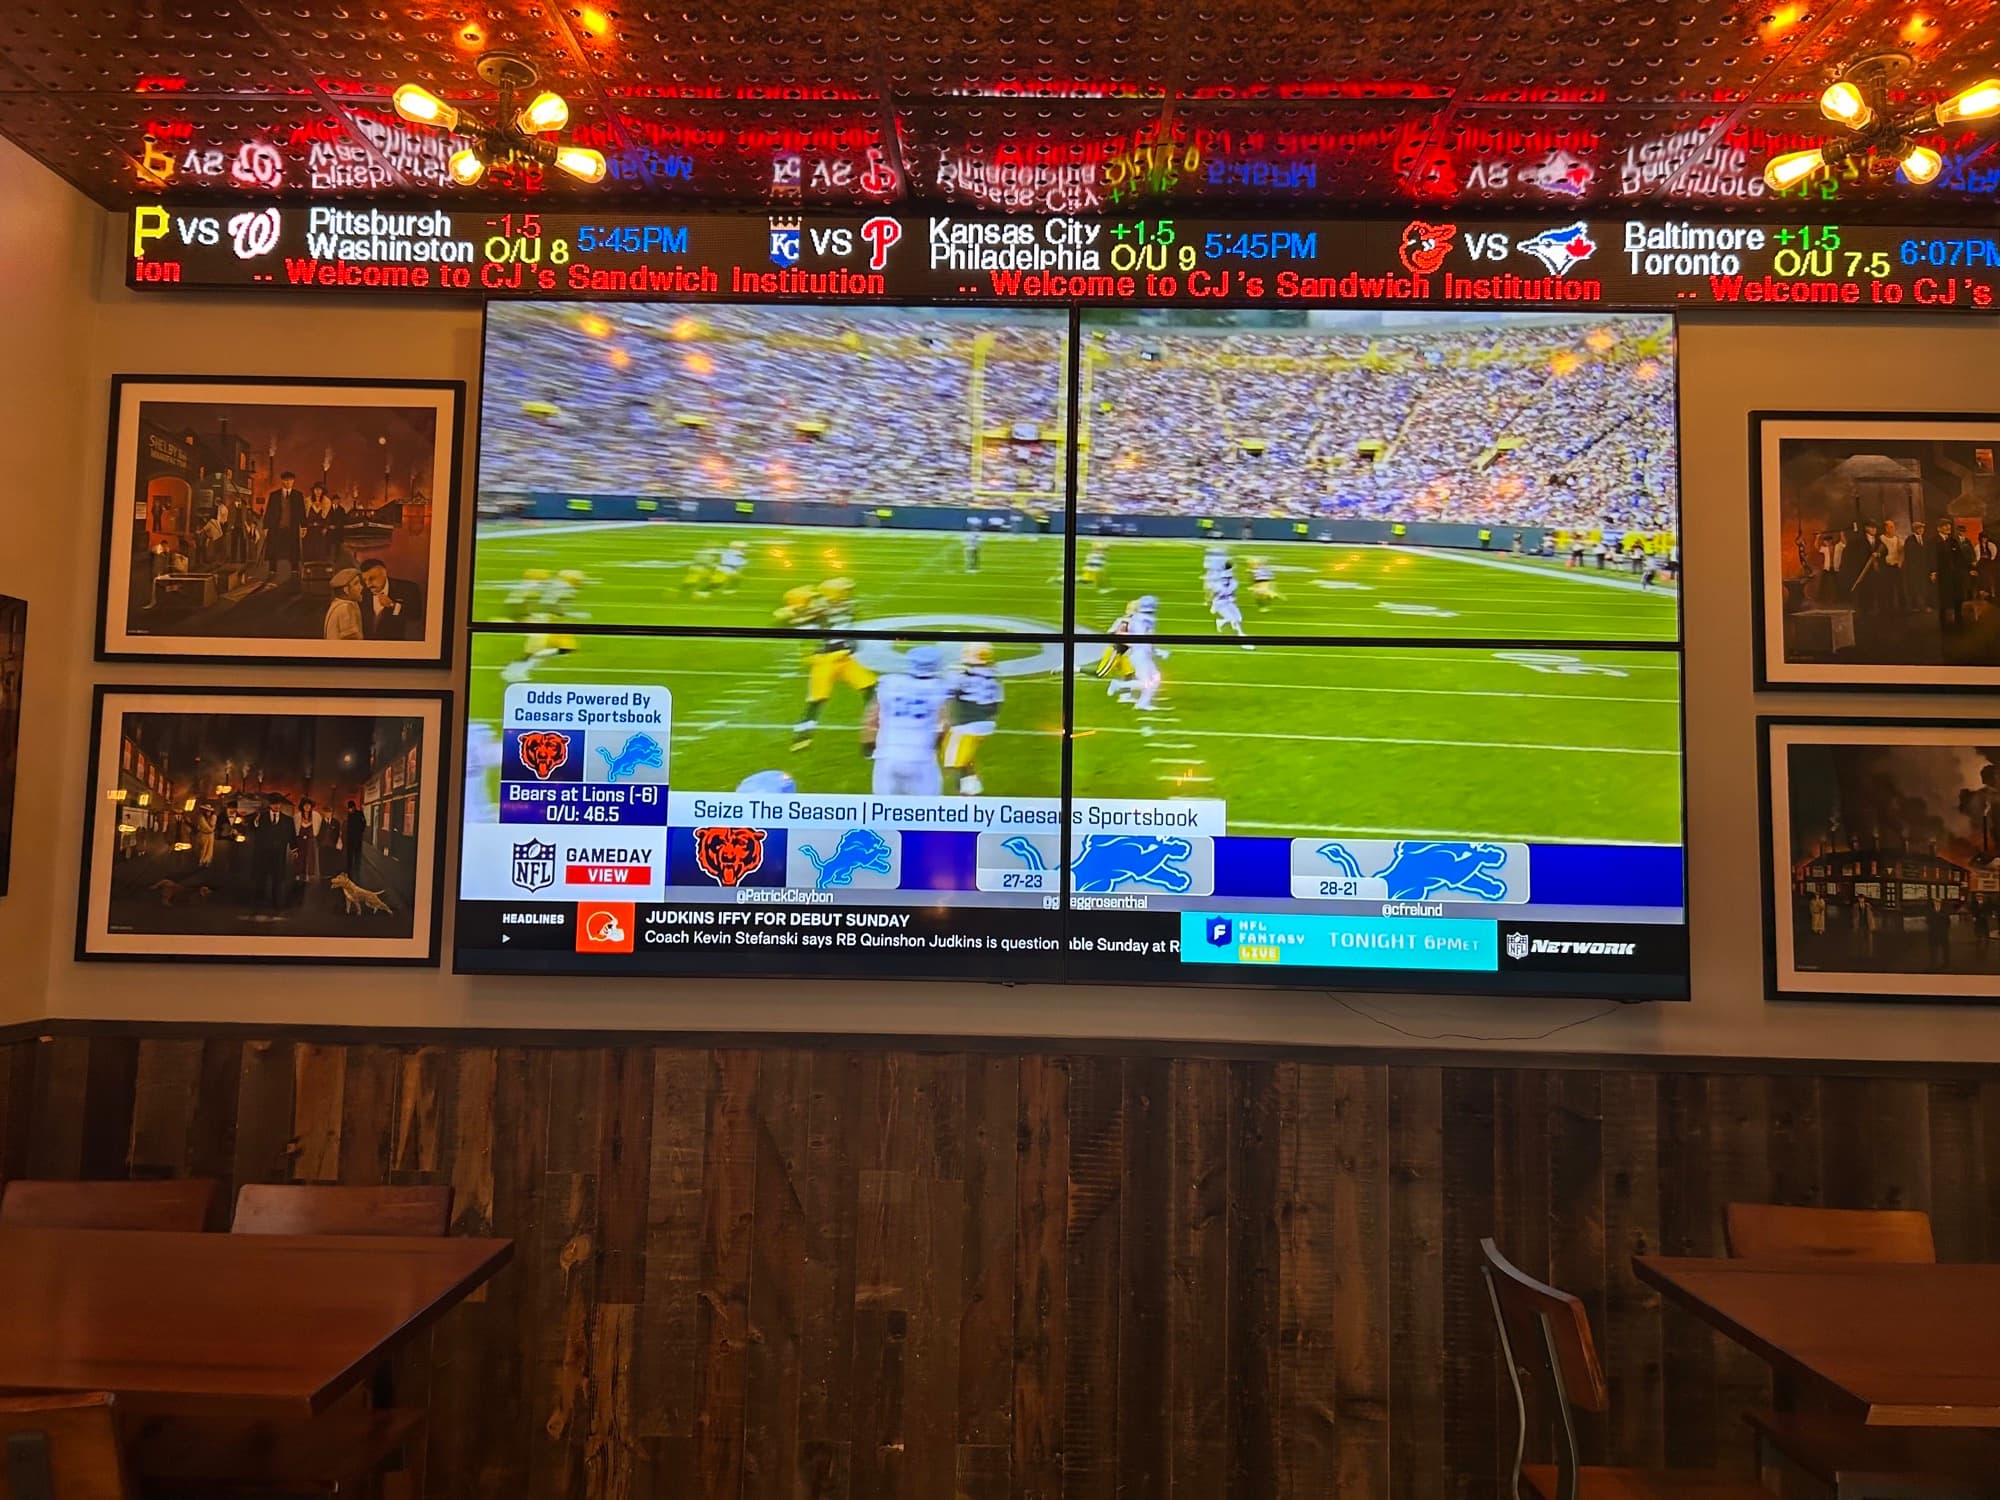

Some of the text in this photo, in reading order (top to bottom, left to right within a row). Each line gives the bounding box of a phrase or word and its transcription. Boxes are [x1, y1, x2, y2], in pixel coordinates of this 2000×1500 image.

[310, 206, 452, 237] Pittsburgh
[486, 213, 542, 239] -1.5
[929, 217, 1101, 245] Kansas City
[1110, 220, 1176, 245] +1.5
[306, 232, 475, 263] Washington
[577, 225, 689, 253] 5:45PM
[1204, 231, 1318, 259] 5:45PM
[1625, 221, 1765, 250] Baltimore
[1773, 225, 1841, 250] +1.5
[484, 236, 570, 264] O/U 8
[930, 243, 1101, 270] Philadelphia
[1110, 244, 1196, 271] O/U 9
[1625, 249, 1741, 275] Toronto
[1773, 249, 1890, 277] O/U 7.5
[136, 256, 181, 283] ion
[285, 258, 430, 287] Welcome
[440, 264, 470, 288] to
[568, 263, 718, 292] Sandwich
[732, 265, 885, 294] Institution
[990, 269, 1136, 297] Welcome
[1146, 272, 1177, 297] to
[1276, 270, 1430, 299] Sandwich
[1444, 272, 1602, 301] Institution
[1708, 275, 1860, 303] Welcome
[1870, 279, 1903, 304] to
[527, 691, 651, 709] Odds Powered By
[514, 707, 662, 725] Caesars Sportsbook
[509, 785, 658, 806] Bears at Lions (-6)
[546, 804, 620, 822] O/U: 46.5
[694, 799, 744, 819] Seize
[750, 800, 783, 820] The
[788, 801, 857, 821] Season
[871, 802, 968, 823] Presented
[974, 804, 995, 827] by
[1088, 805, 1199, 829] Sportsbook
[566, 847, 652, 864] GAMEDAY
[515, 862, 552, 886] NFL
[587, 867, 630, 883] VIEW
[1002, 873, 1043, 888] 27-23
[736, 888, 834, 905] @PatrickClaybon
[1319, 881, 1358, 897] 28-21
[501, 912, 565, 925] HEADLINES
[645, 910, 911, 928] JUDKINS IFFY FOR DEBUT SUNDAY
[1381, 903, 1443, 918] @cfrelund
[1239, 921, 1267, 931] NFL
[644, 930, 690, 945] Coach
[693, 931, 732, 946] Kevin
[734, 931, 798, 947] Stefanski
[801, 934, 832, 950] says
[836, 933, 857, 947] RB
[860, 933, 925, 949] Quinshon
[928, 934, 983, 950] Judkins
[986, 935, 997, 950] is
[1096, 937, 1147, 955] Sunday
[1151, 939, 1166, 953] at
[1239, 932, 1306, 945] FANTASY
[1328, 931, 1416, 950] TONIGHT
[1508, 942, 1527, 954] NFL
[1241, 946, 1277, 959] LIVE
